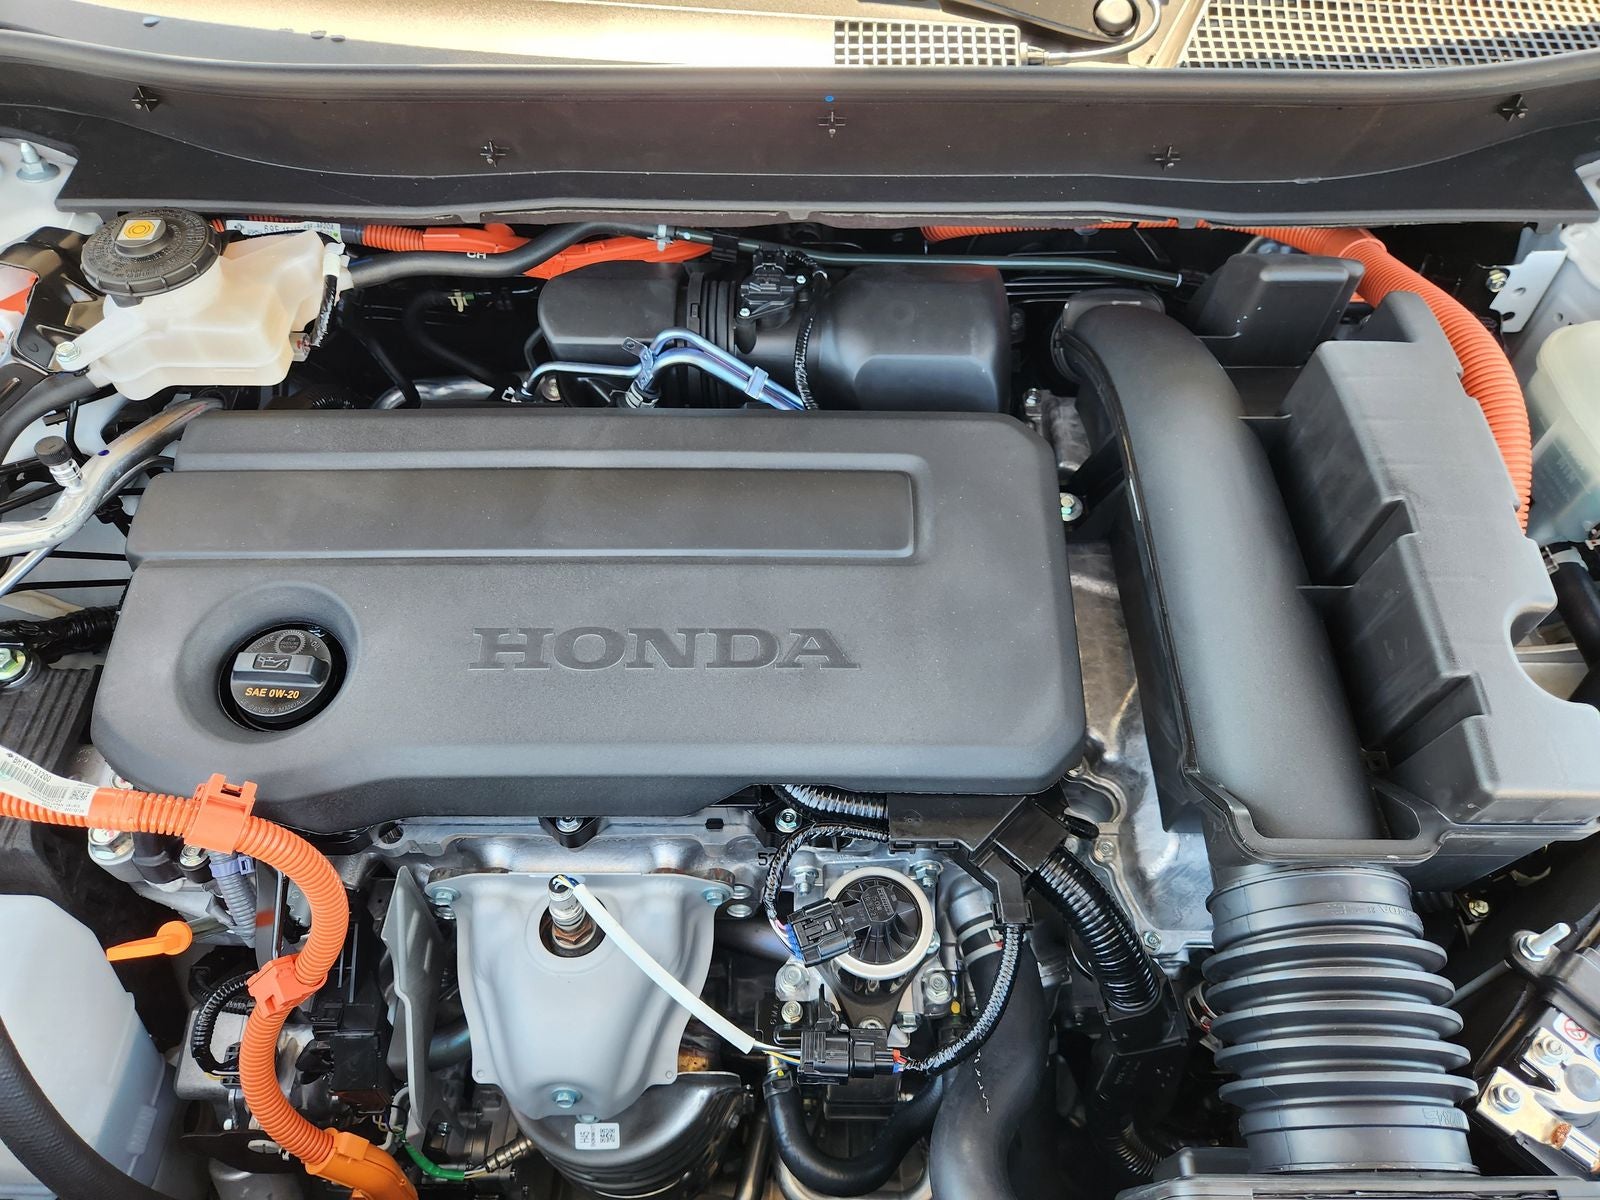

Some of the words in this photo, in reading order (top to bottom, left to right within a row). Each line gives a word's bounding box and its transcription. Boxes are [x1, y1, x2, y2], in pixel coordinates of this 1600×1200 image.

[468, 627, 861, 671] HONDA
[245, 687, 268, 698] SAE
[268, 688, 300, 699] 0W-20
